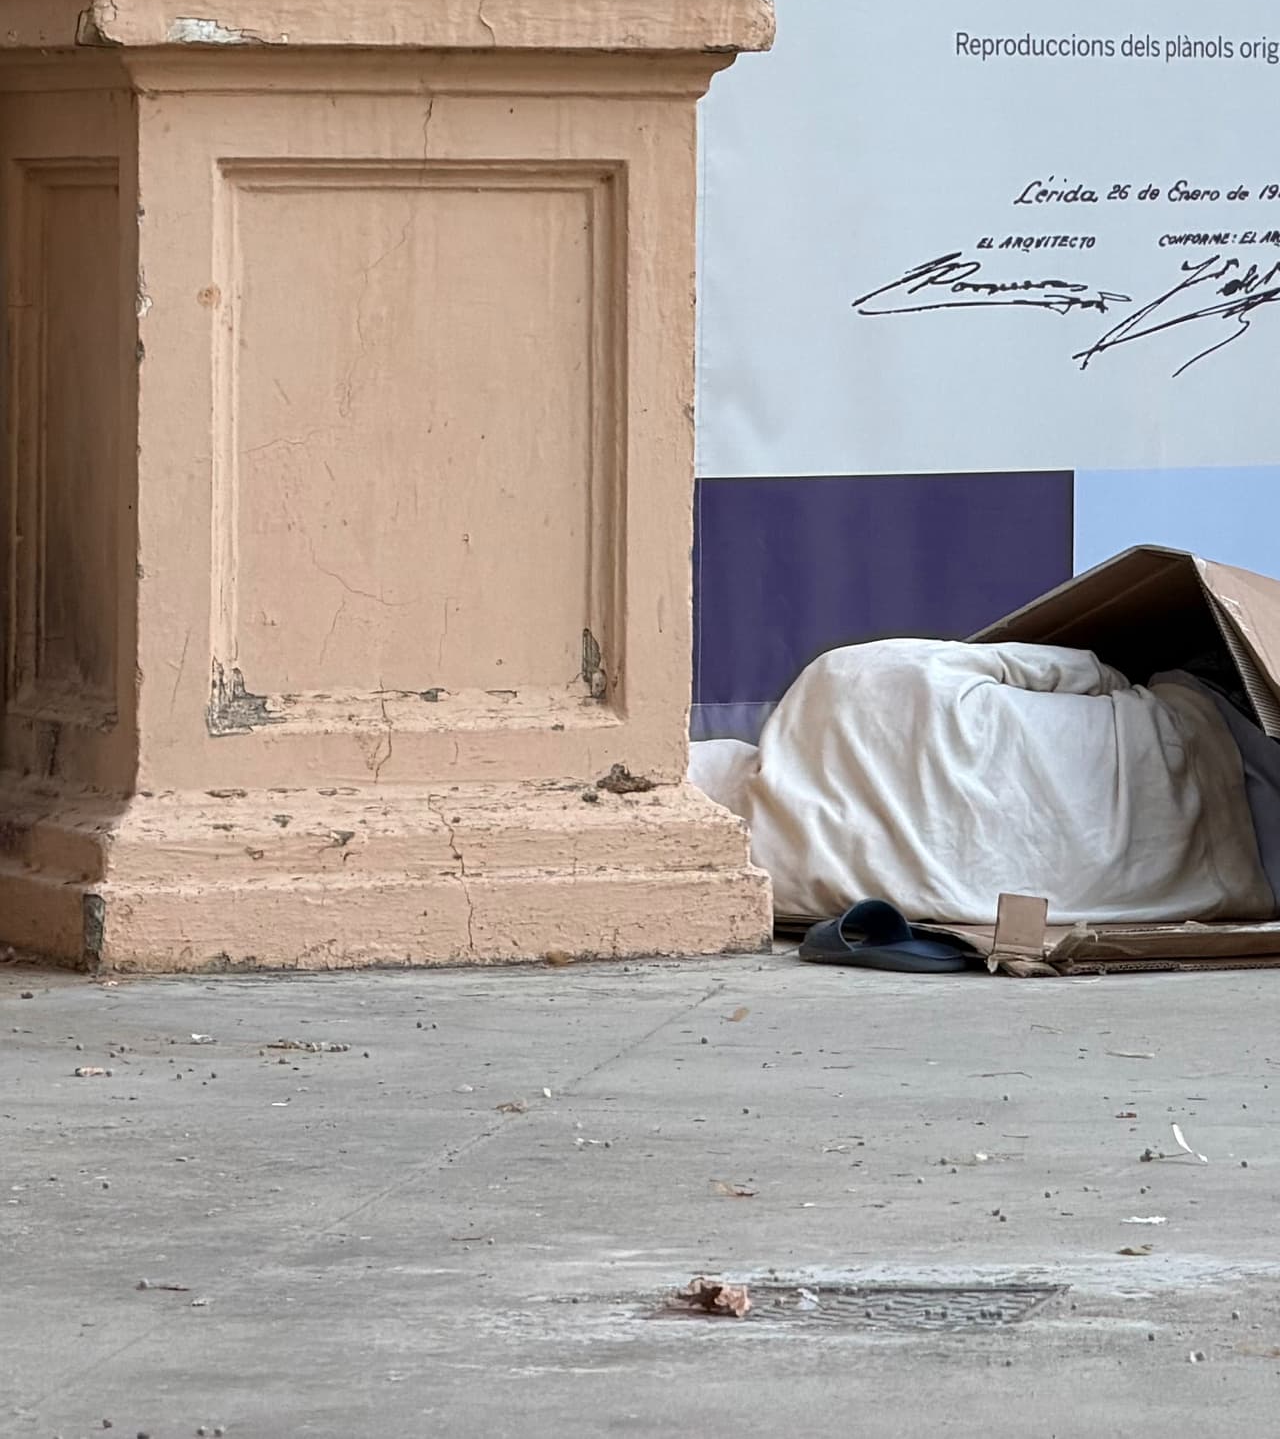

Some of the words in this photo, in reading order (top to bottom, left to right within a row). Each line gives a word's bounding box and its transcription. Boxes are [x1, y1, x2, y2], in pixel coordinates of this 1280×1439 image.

[956, 32, 1116, 62] Reproduccions
[1120, 33, 1161, 58] dels
[1165, 34, 1234, 63] plànols
[1106, 184, 1132, 200] 26
[1137, 183, 1161, 201] de
[1167, 179, 1221, 202] Enero
[1226, 184, 1250, 201] de
[976, 237, 994, 249] EL
[1238, 231, 1257, 245] EL
